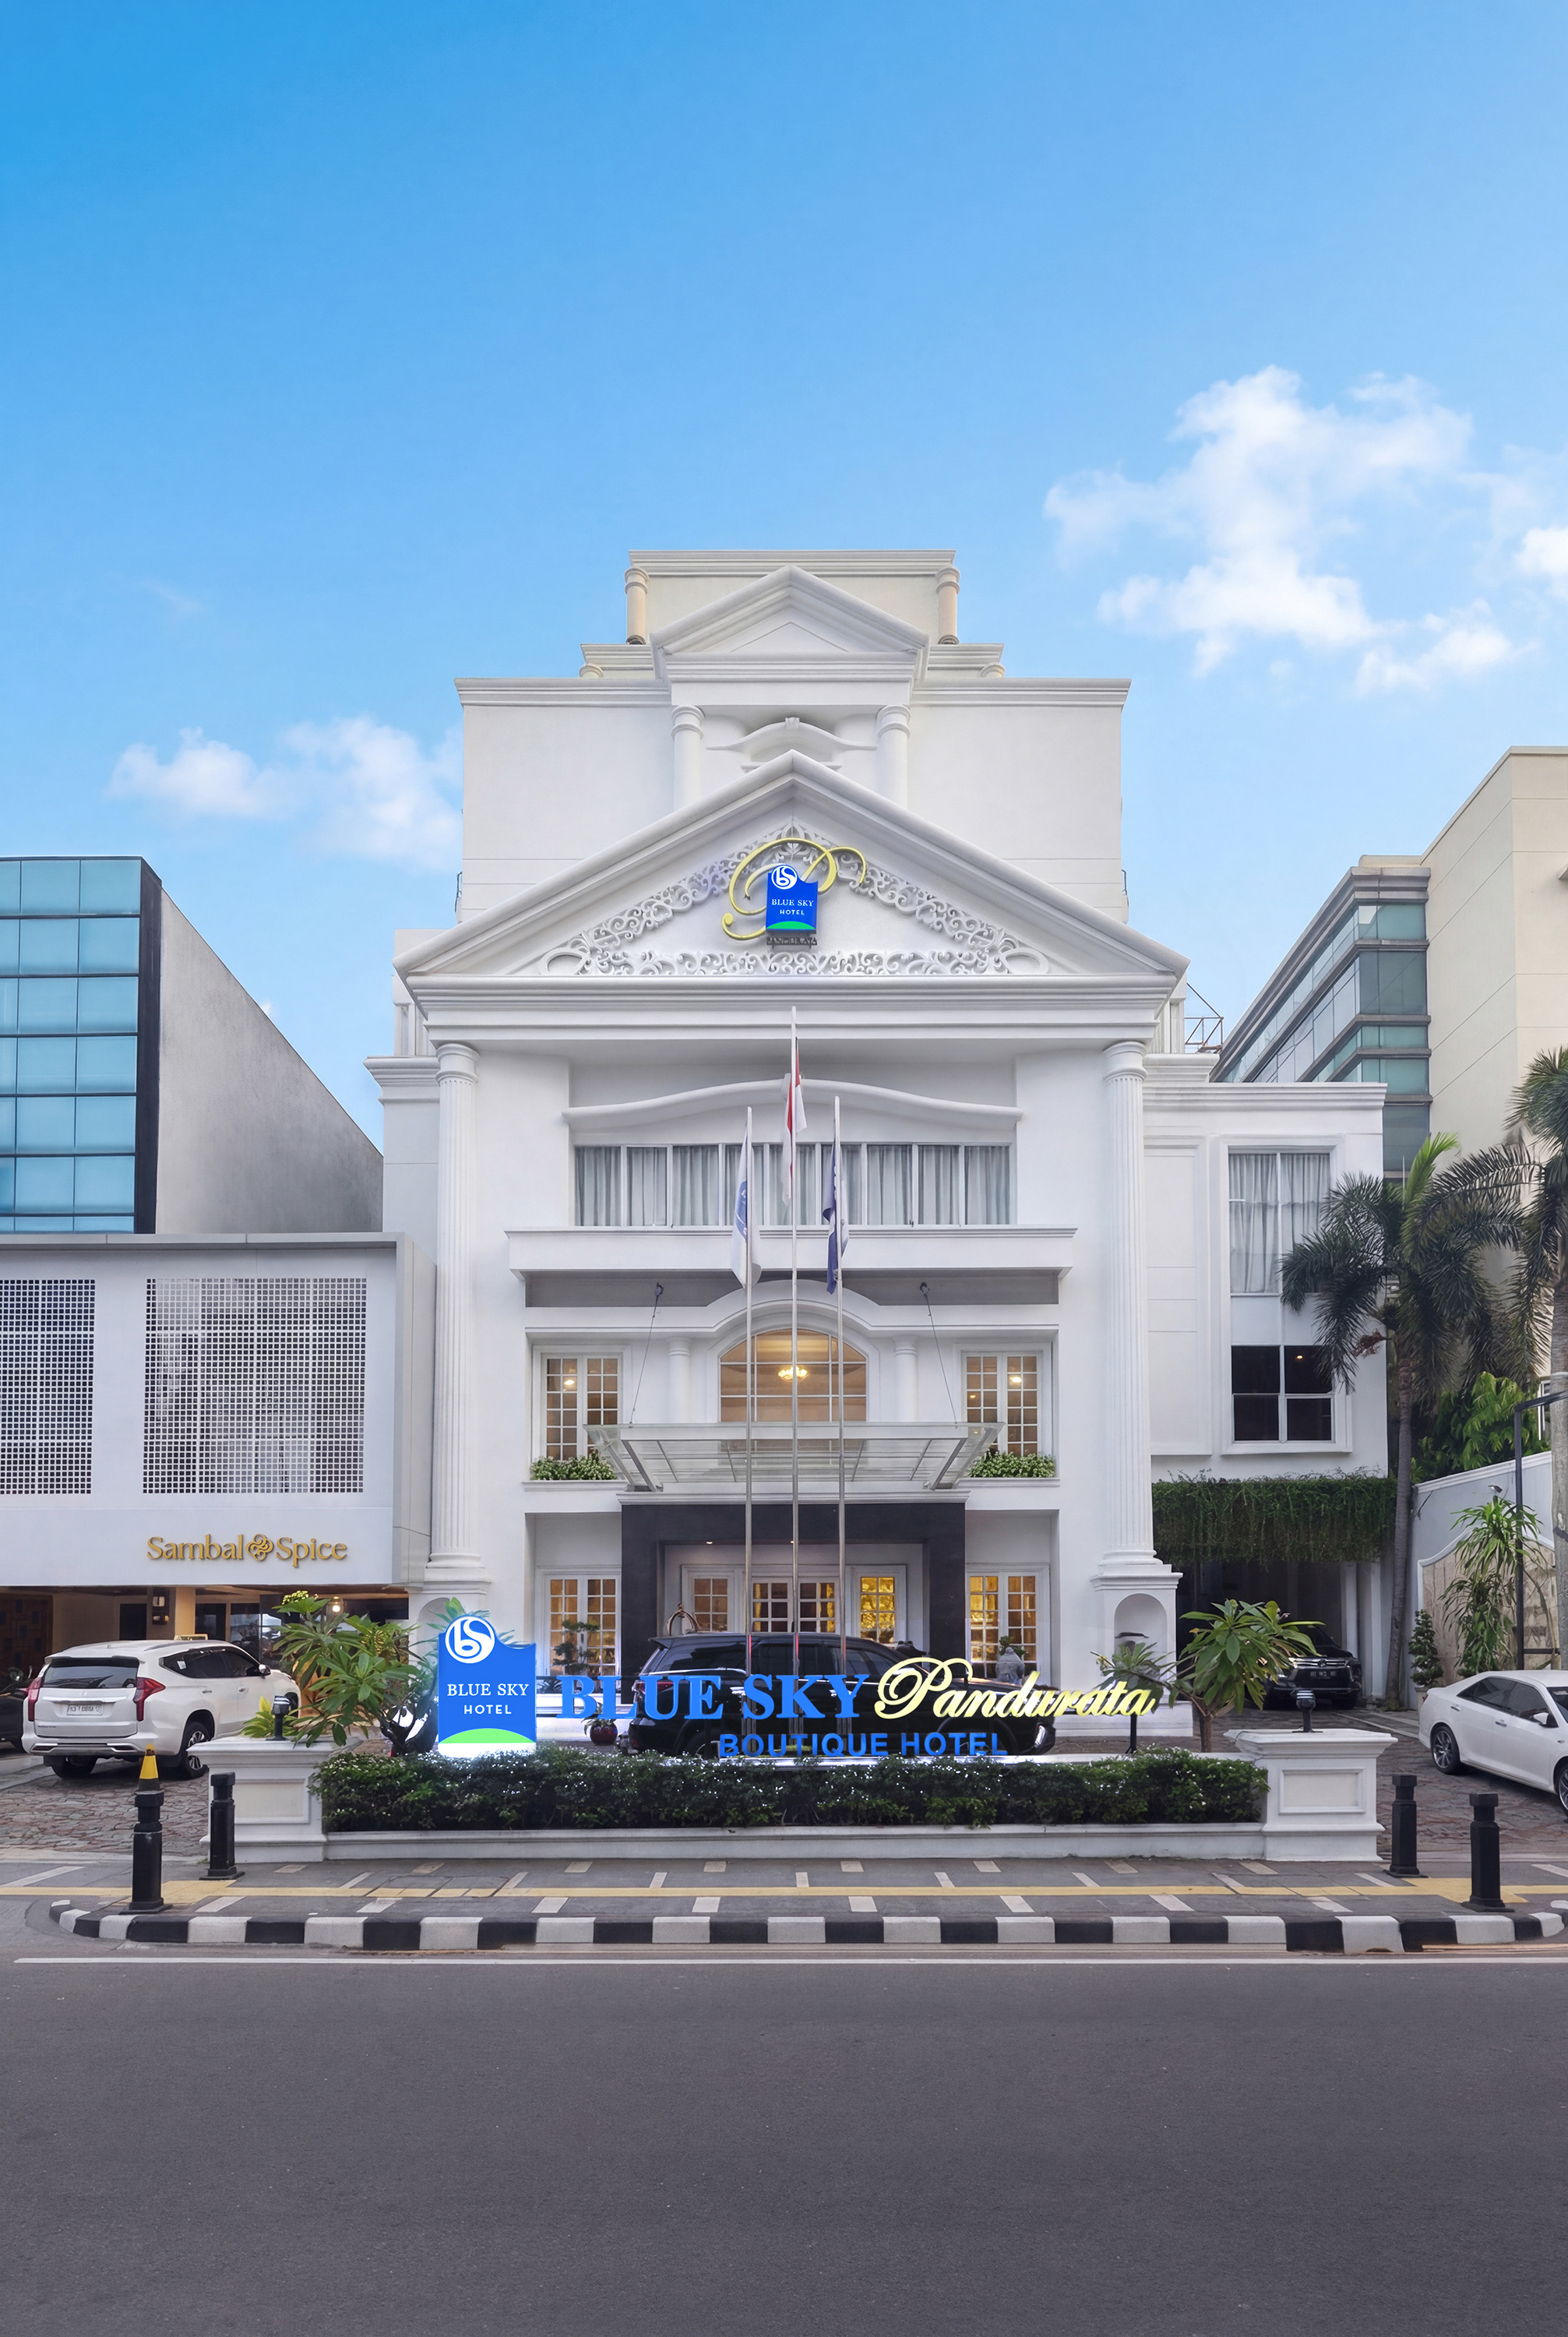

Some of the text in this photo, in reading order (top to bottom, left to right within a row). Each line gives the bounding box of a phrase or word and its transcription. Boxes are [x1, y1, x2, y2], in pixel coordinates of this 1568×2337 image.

[147, 1533, 347, 1567] Sambal Spice
[446, 1683, 529, 1697] BLUE SKY
[556, 1656, 1157, 1720] BLUE SKY Pandurata
[463, 1704, 513, 1715] HOTEL
[720, 1732, 1009, 1758] BOUTIQUE HOTEL
